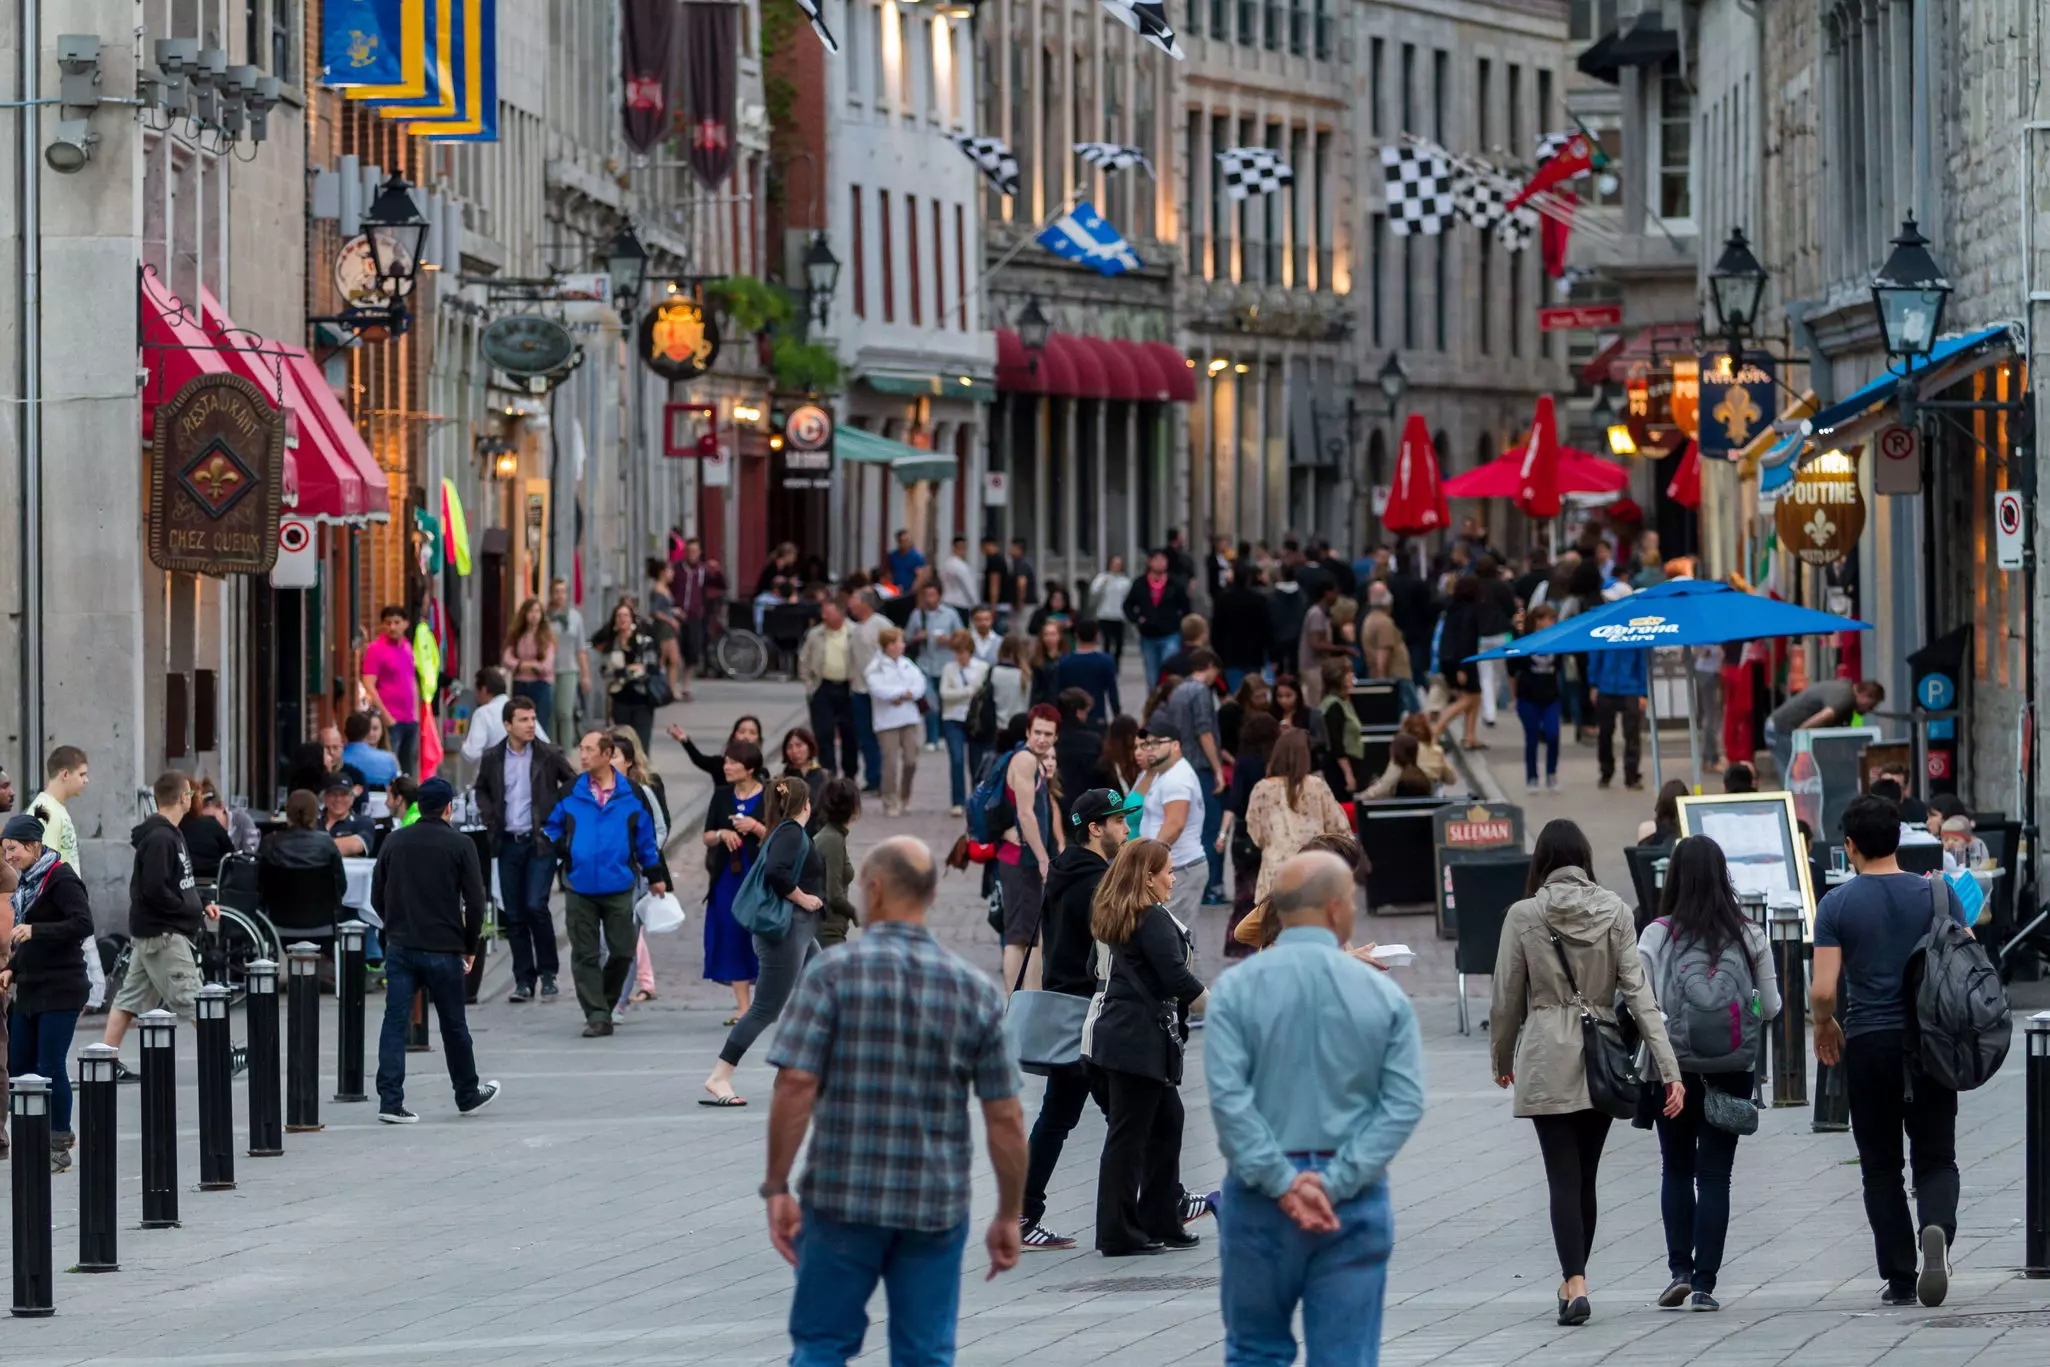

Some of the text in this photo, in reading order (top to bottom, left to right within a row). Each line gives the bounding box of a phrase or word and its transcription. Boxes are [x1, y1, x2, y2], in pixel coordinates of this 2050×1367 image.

[182, 394, 261, 437] RESTAURANT
[1783, 481, 1856, 504] POUTINE
[169, 529, 206, 549] CHEZ
[1590, 624, 1679, 638] Corona
[1607, 634, 1655, 643] Extra
[1449, 822, 1509, 841] SLEEMAN
